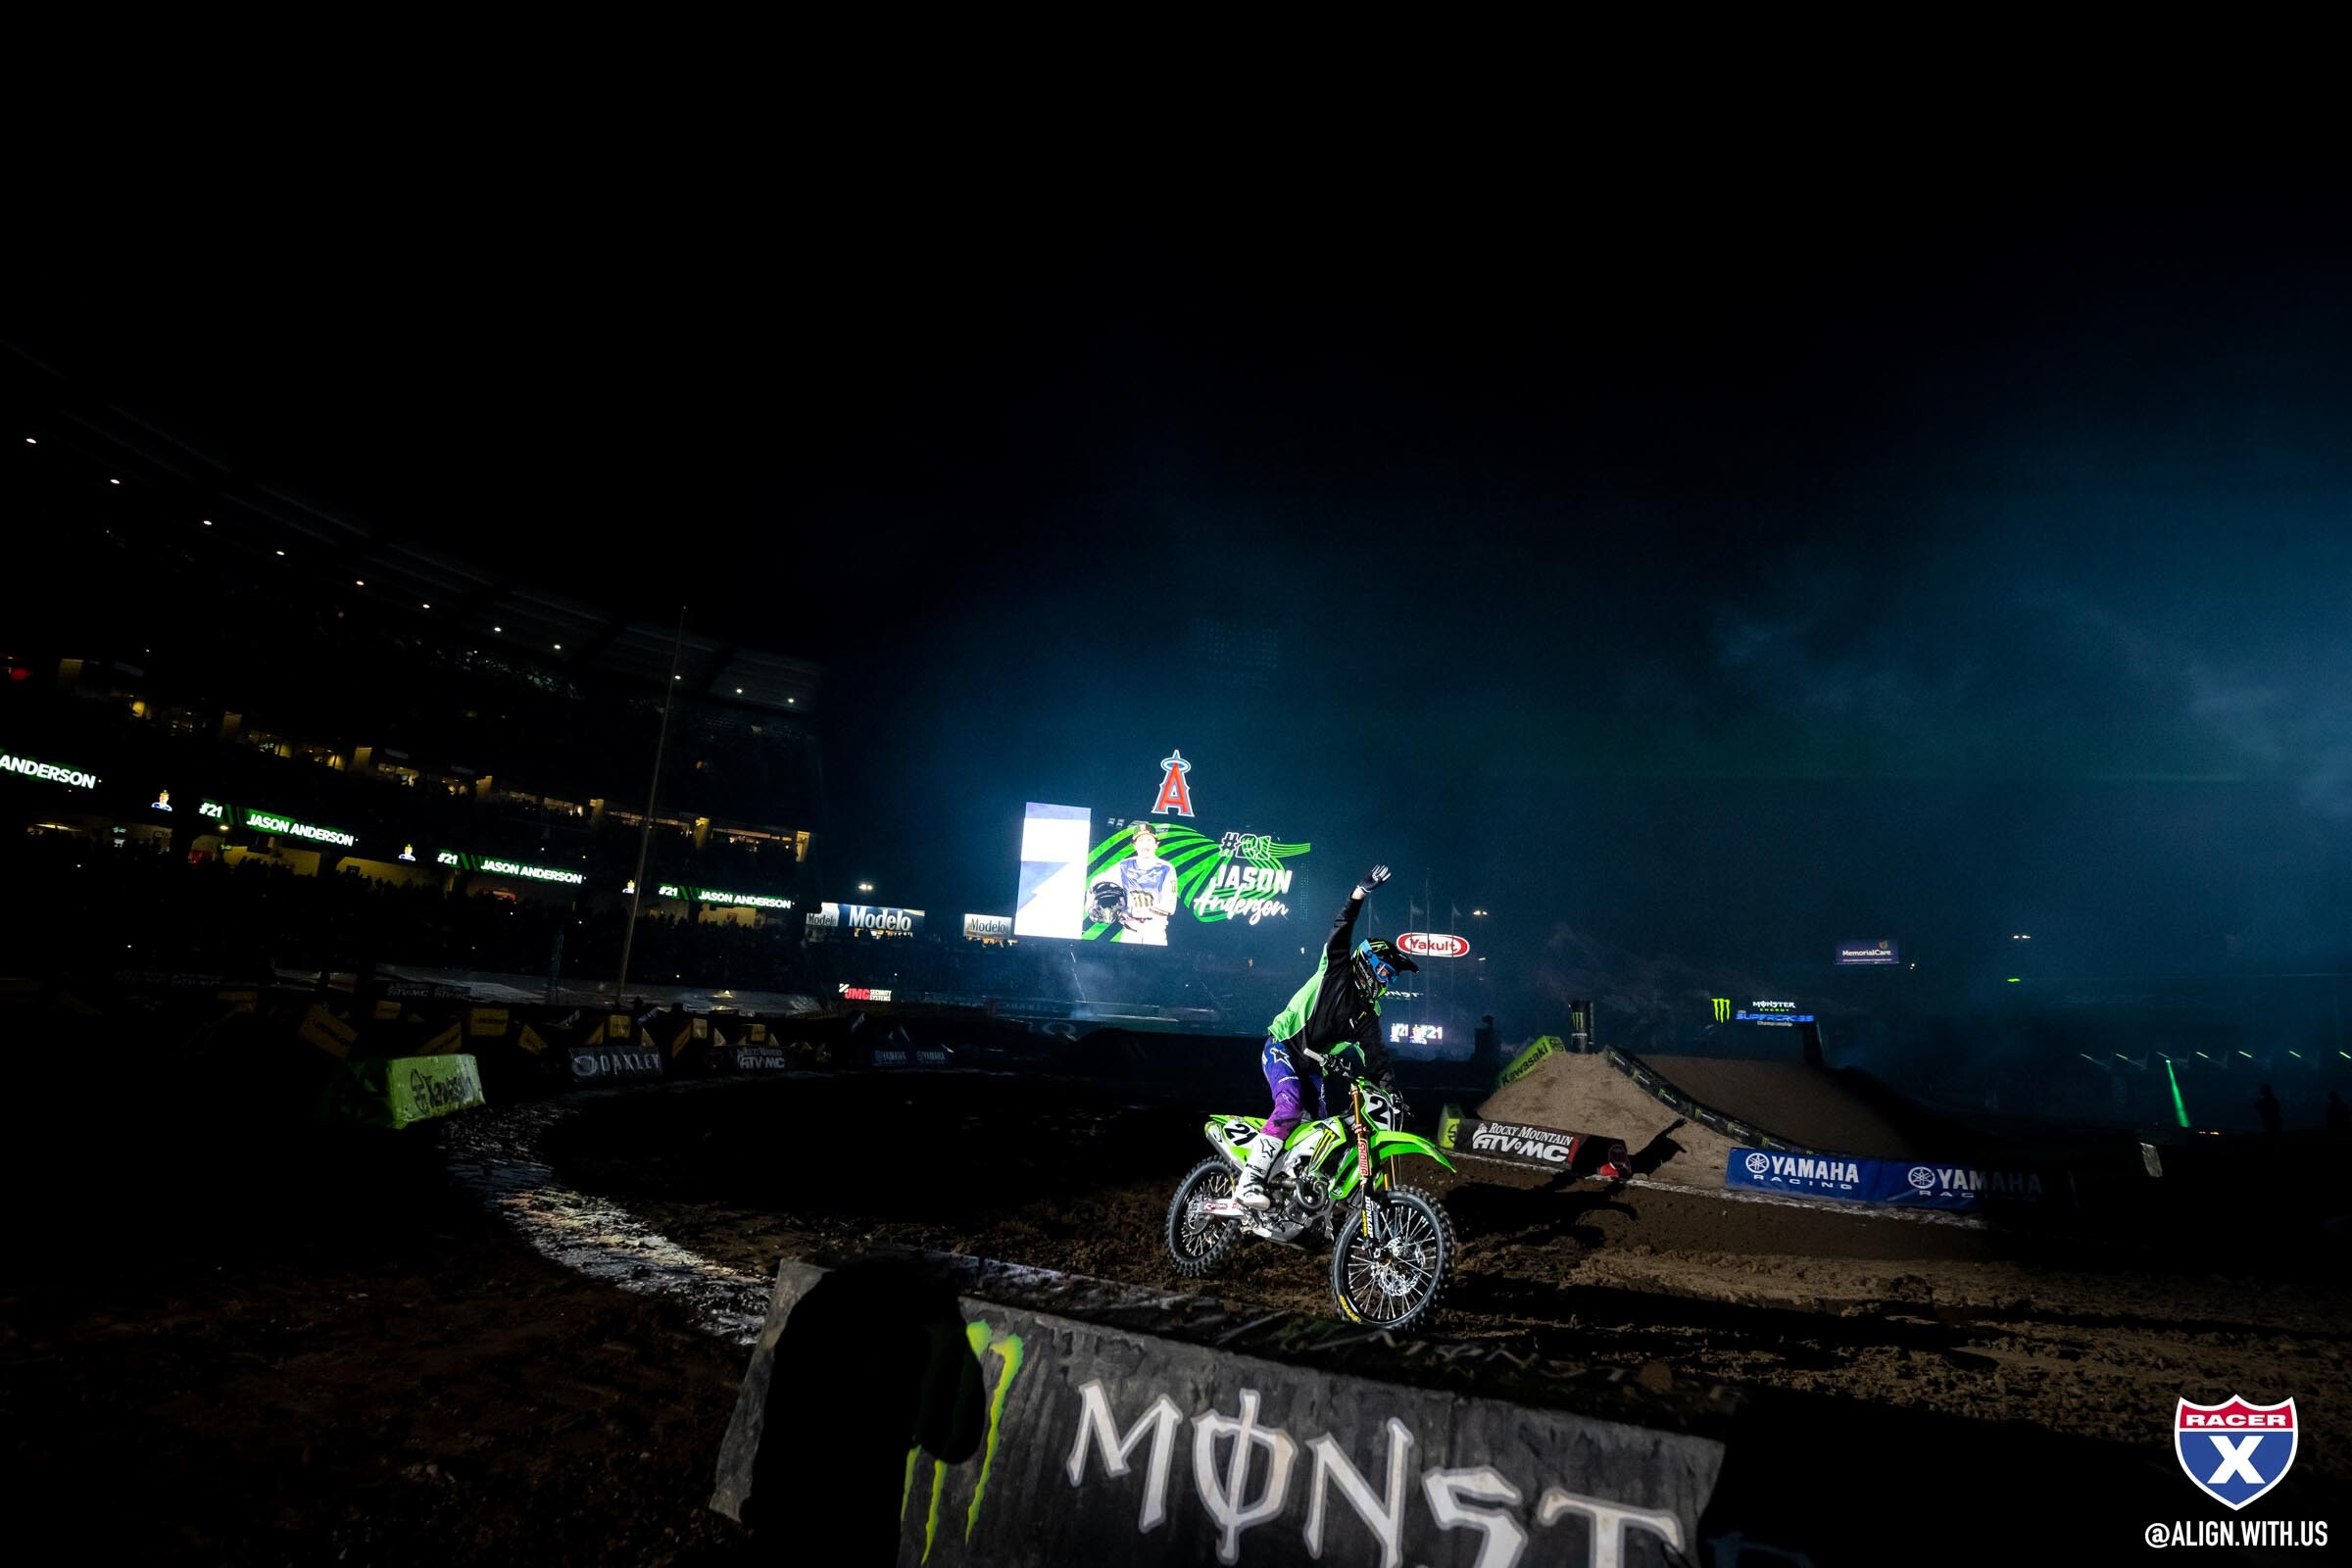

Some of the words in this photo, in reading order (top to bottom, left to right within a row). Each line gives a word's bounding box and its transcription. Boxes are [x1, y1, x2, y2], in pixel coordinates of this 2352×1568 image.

[0, 754, 95, 789] ANDERSON
[199, 802, 222, 818] #21
[246, 813, 289, 833] JASON
[290, 822, 353, 846] ANDERSON
[437, 851, 458, 865] #21
[1219, 832, 1271, 860] #21
[480, 859, 519, 877] JASON
[520, 866, 582, 884] ANDERSON
[1215, 864, 1292, 894] JASON
[659, 885, 678, 897] #21
[699, 891, 733, 904] JASON
[734, 895, 791, 908] ANDERSON
[1194, 877, 1289, 925] Anderson
[849, 905, 912, 931] Modelo
[970, 917, 1005, 933] Modelo
[1411, 939, 1458, 953] Yakult
[844, 987, 870, 1000] JMG
[1752, 1000, 1795, 1008] MONSTER
[1502, 1042, 1548, 1087] Kawasaki
[1224, 1123, 1258, 1147] 21
[1489, 1122, 1519, 1137] ROCKY
[1518, 1126, 1574, 1146] MOUNTAIN
[1772, 1155, 1860, 1183] YAMAHA
[1753, 1173, 1853, 1191] RACING
[1937, 1168, 2046, 1195] YAMAHA
